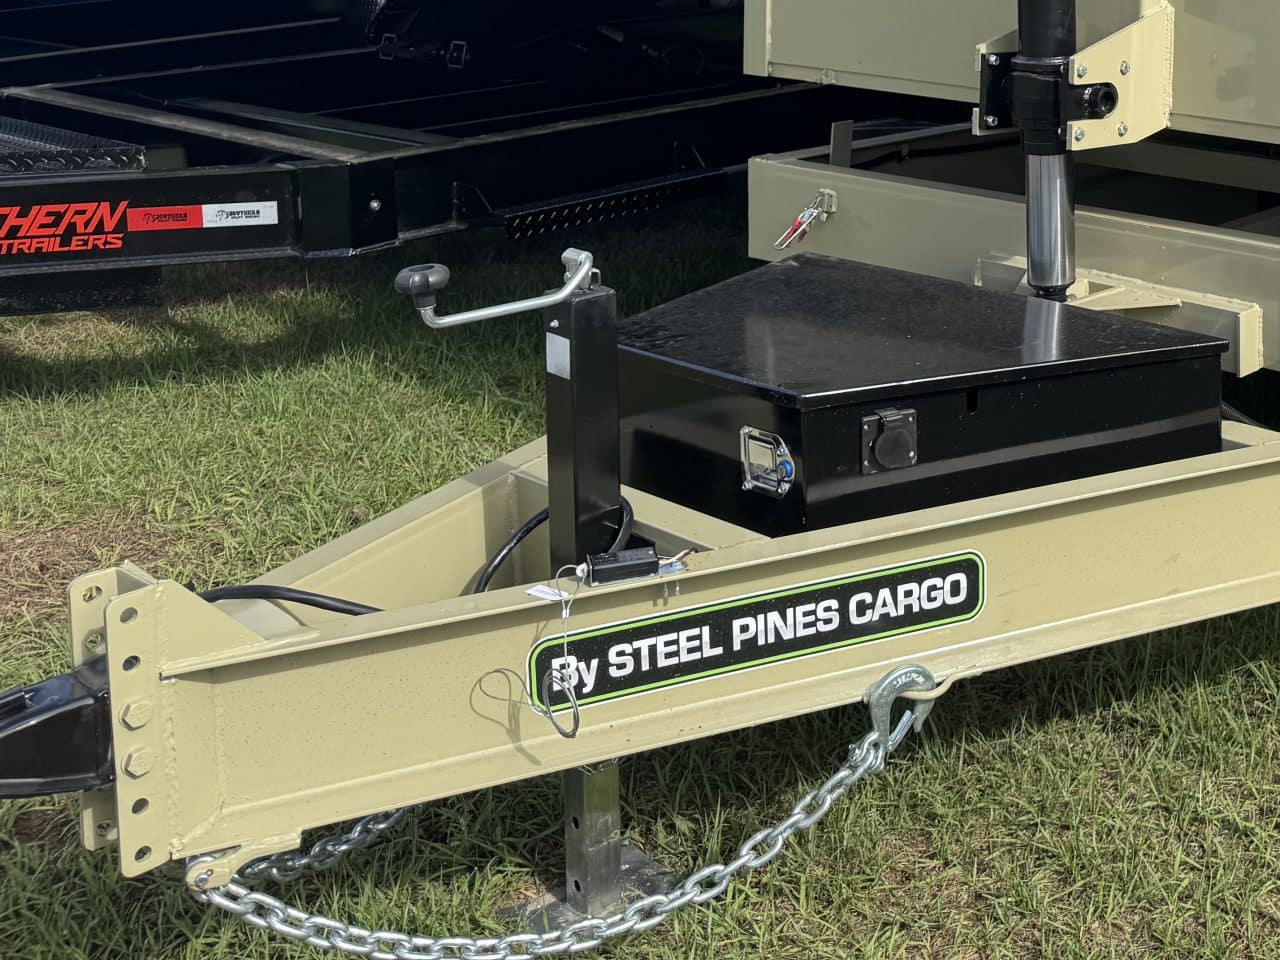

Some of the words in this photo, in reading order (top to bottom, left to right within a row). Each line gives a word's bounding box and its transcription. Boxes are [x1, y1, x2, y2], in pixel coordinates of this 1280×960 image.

[0, 233, 124, 255] TRAILERS
[551, 655, 599, 694] By
[608, 627, 724, 679] STEEL
[732, 599, 839, 652] PINES
[849, 572, 968, 626] CARGO
